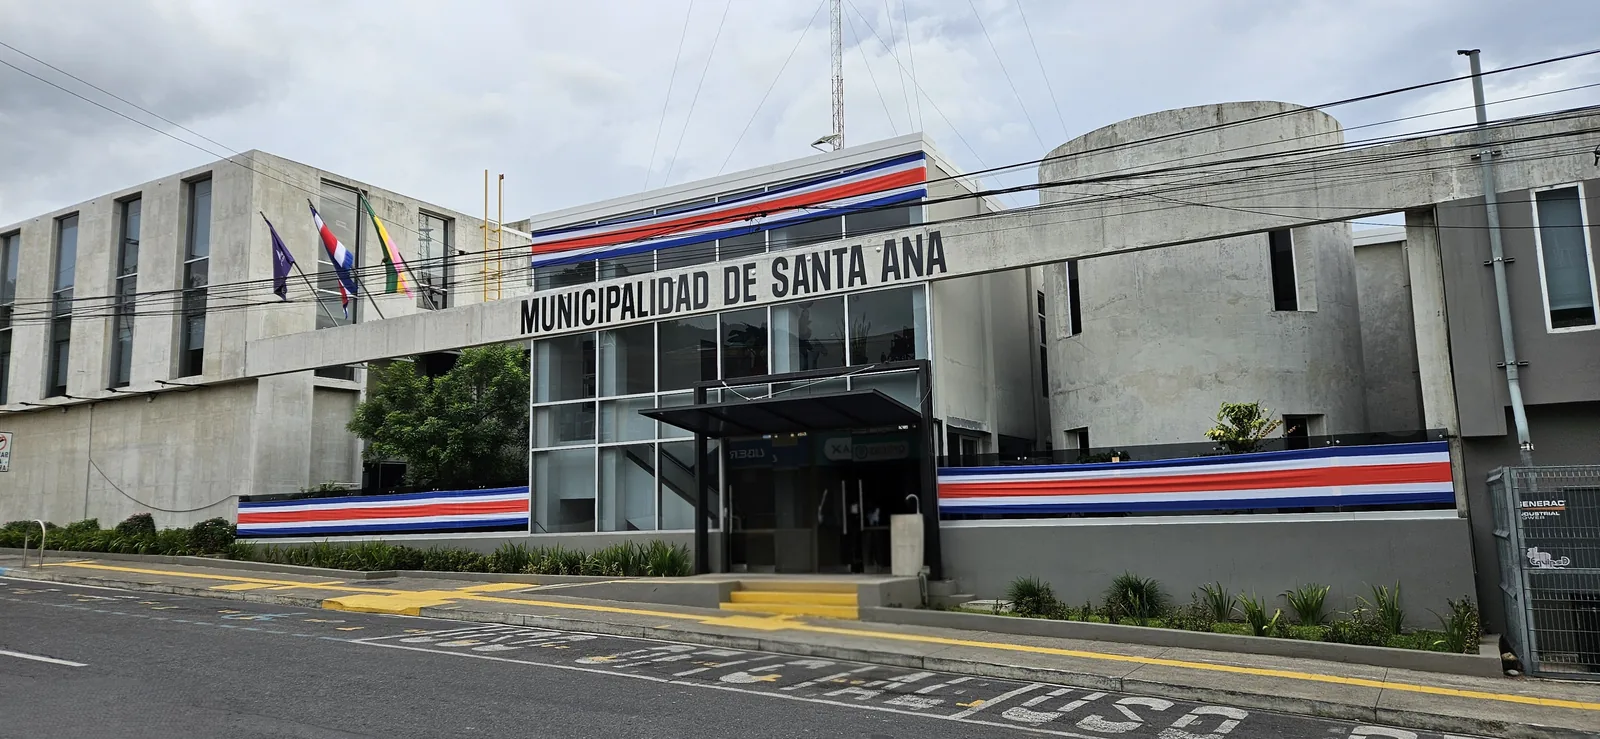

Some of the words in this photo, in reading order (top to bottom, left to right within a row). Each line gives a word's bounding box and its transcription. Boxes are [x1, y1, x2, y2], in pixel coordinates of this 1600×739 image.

[520, 270, 709, 335] MUNICIPALIDAD
[723, 262, 757, 305] DE
[771, 244, 867, 298] SANTA
[881, 231, 948, 283] ANA
